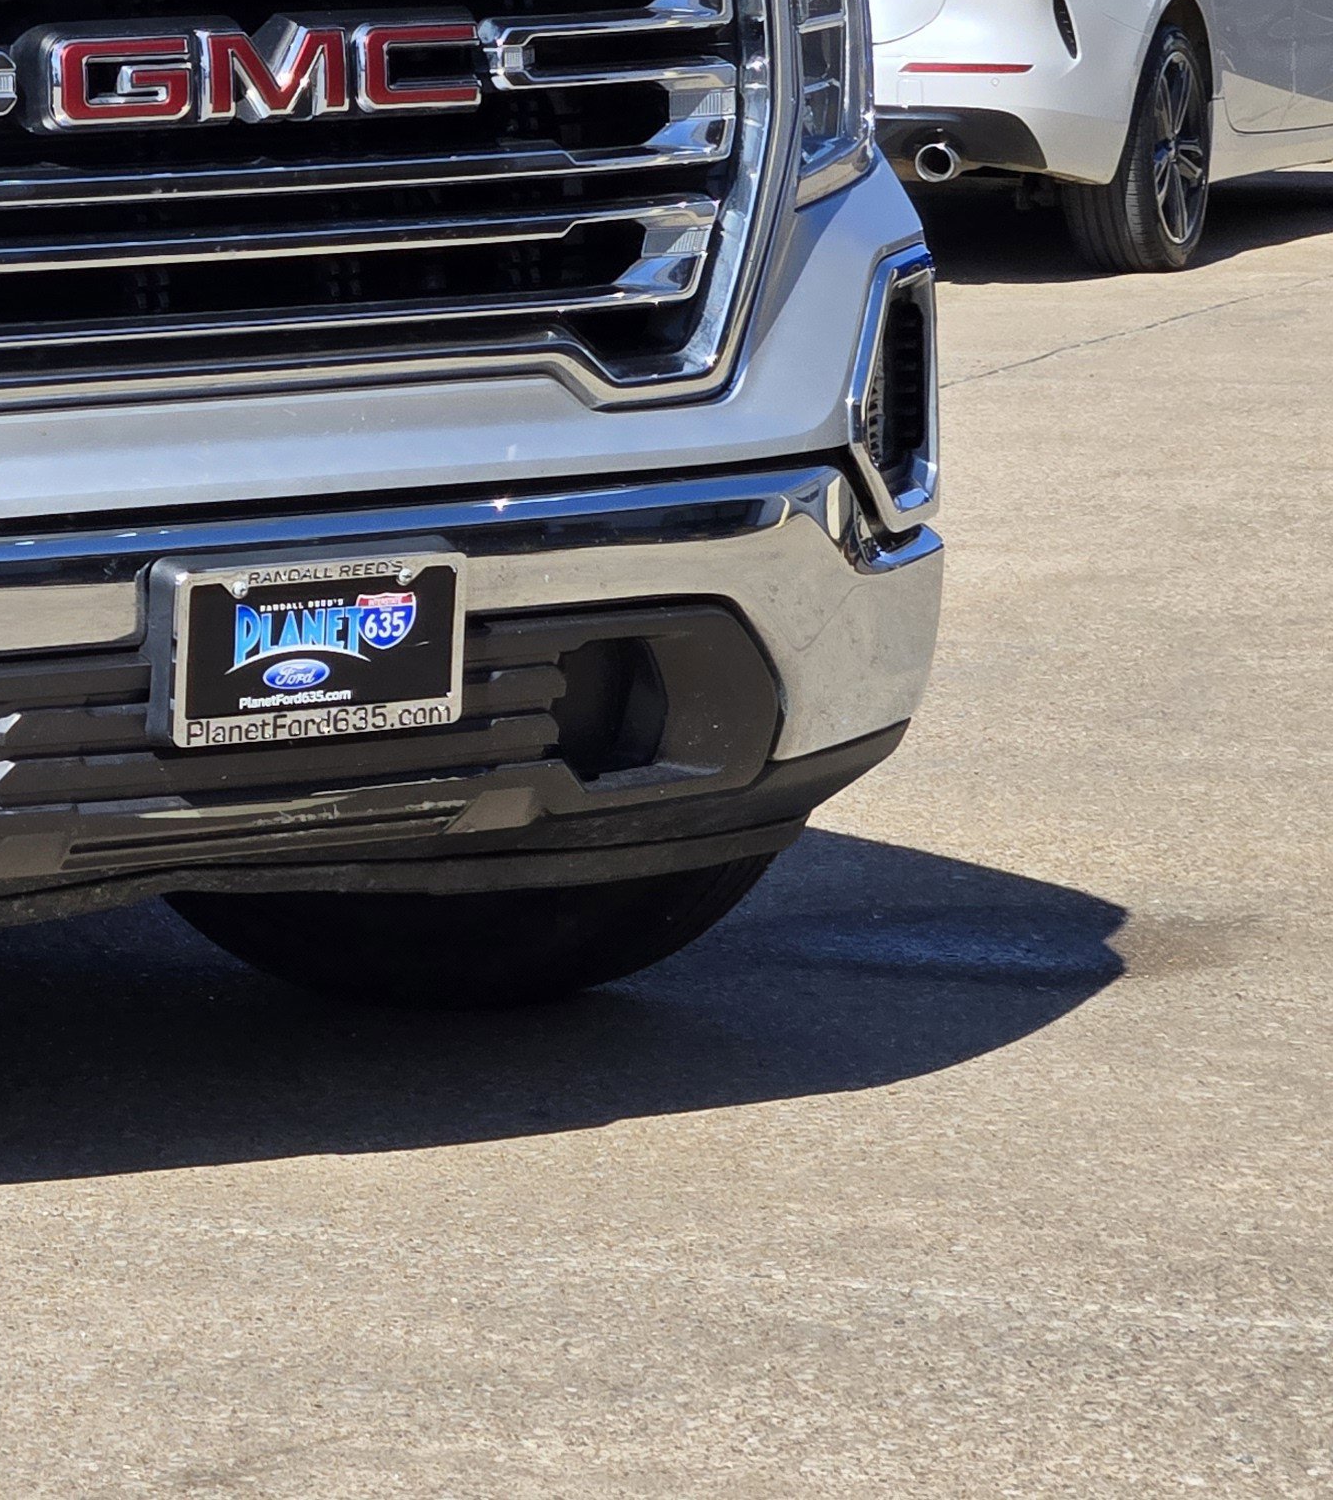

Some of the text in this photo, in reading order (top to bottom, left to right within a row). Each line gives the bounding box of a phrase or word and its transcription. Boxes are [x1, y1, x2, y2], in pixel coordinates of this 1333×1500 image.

[49, 23, 482, 126] GMC
[248, 560, 403, 585] RANDALL REED'S
[234, 604, 364, 668] PLANET
[364, 610, 406, 639] 635
[274, 664, 316, 686] Ford
[238, 689, 352, 710] PlanetFord635.com
[185, 703, 452, 747] PlanetFord635.com
